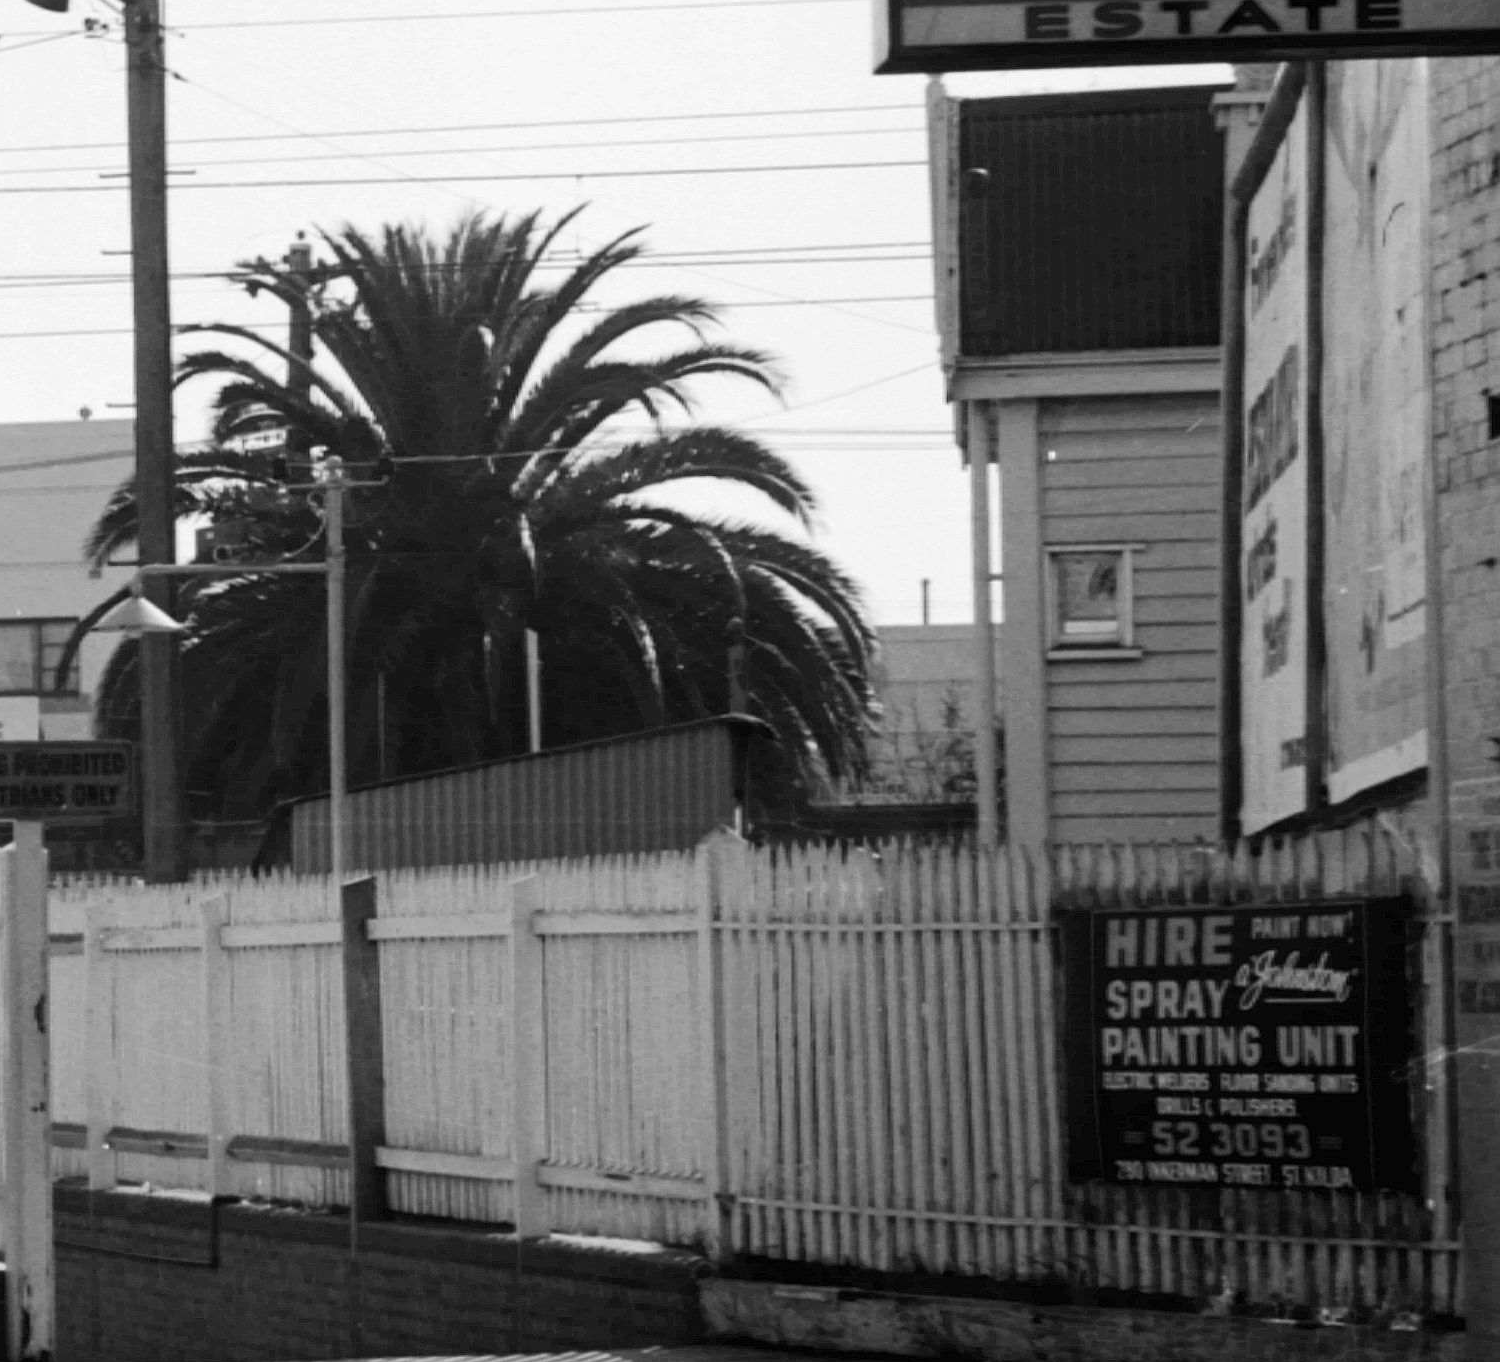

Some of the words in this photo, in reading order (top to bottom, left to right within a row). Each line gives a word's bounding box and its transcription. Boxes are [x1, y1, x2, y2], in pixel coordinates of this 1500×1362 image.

[13, 751, 127, 776] PROHIBITED
[71, 783, 122, 807] ONLY
[1251, 914, 1301, 939] PAINT
[1104, 914, 1235, 969] HIRE
[1105, 979, 1230, 1020] SPRAY
[1101, 1025, 1263, 1067] PAINTING
[1275, 1025, 1360, 1067] UNIT
[1156, 1096, 1201, 1116] DRILLS
[1151, 1120, 1200, 1156] 52
[1209, 1121, 1312, 1159] 3093
[1145, 1159, 1219, 1183] INKERMAN
[1221, 1161, 1271, 1185] STREET
